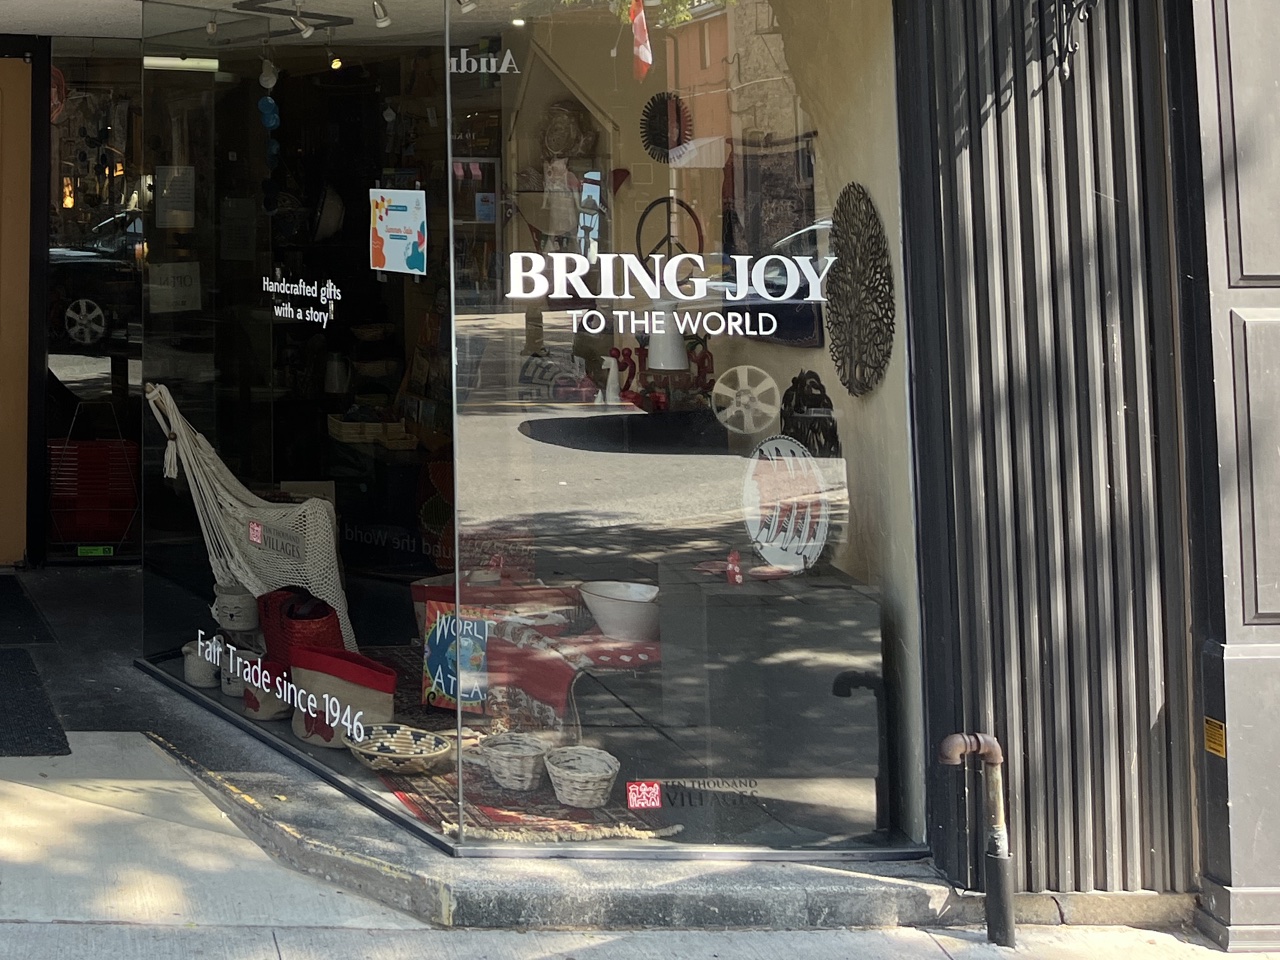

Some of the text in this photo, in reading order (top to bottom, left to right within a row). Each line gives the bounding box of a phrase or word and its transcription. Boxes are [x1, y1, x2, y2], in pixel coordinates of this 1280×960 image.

[262, 276, 342, 304] Handcrafted gifts
[505, 252, 838, 301] BRING JOY
[274, 302, 329, 329] with a story
[567, 310, 778, 336] TO THE WORLD
[262, 534, 301, 559] VILLAGES
[197, 629, 365, 742] Fair Trade since 1946
[664, 779, 758, 789] TEN THOUSAND
